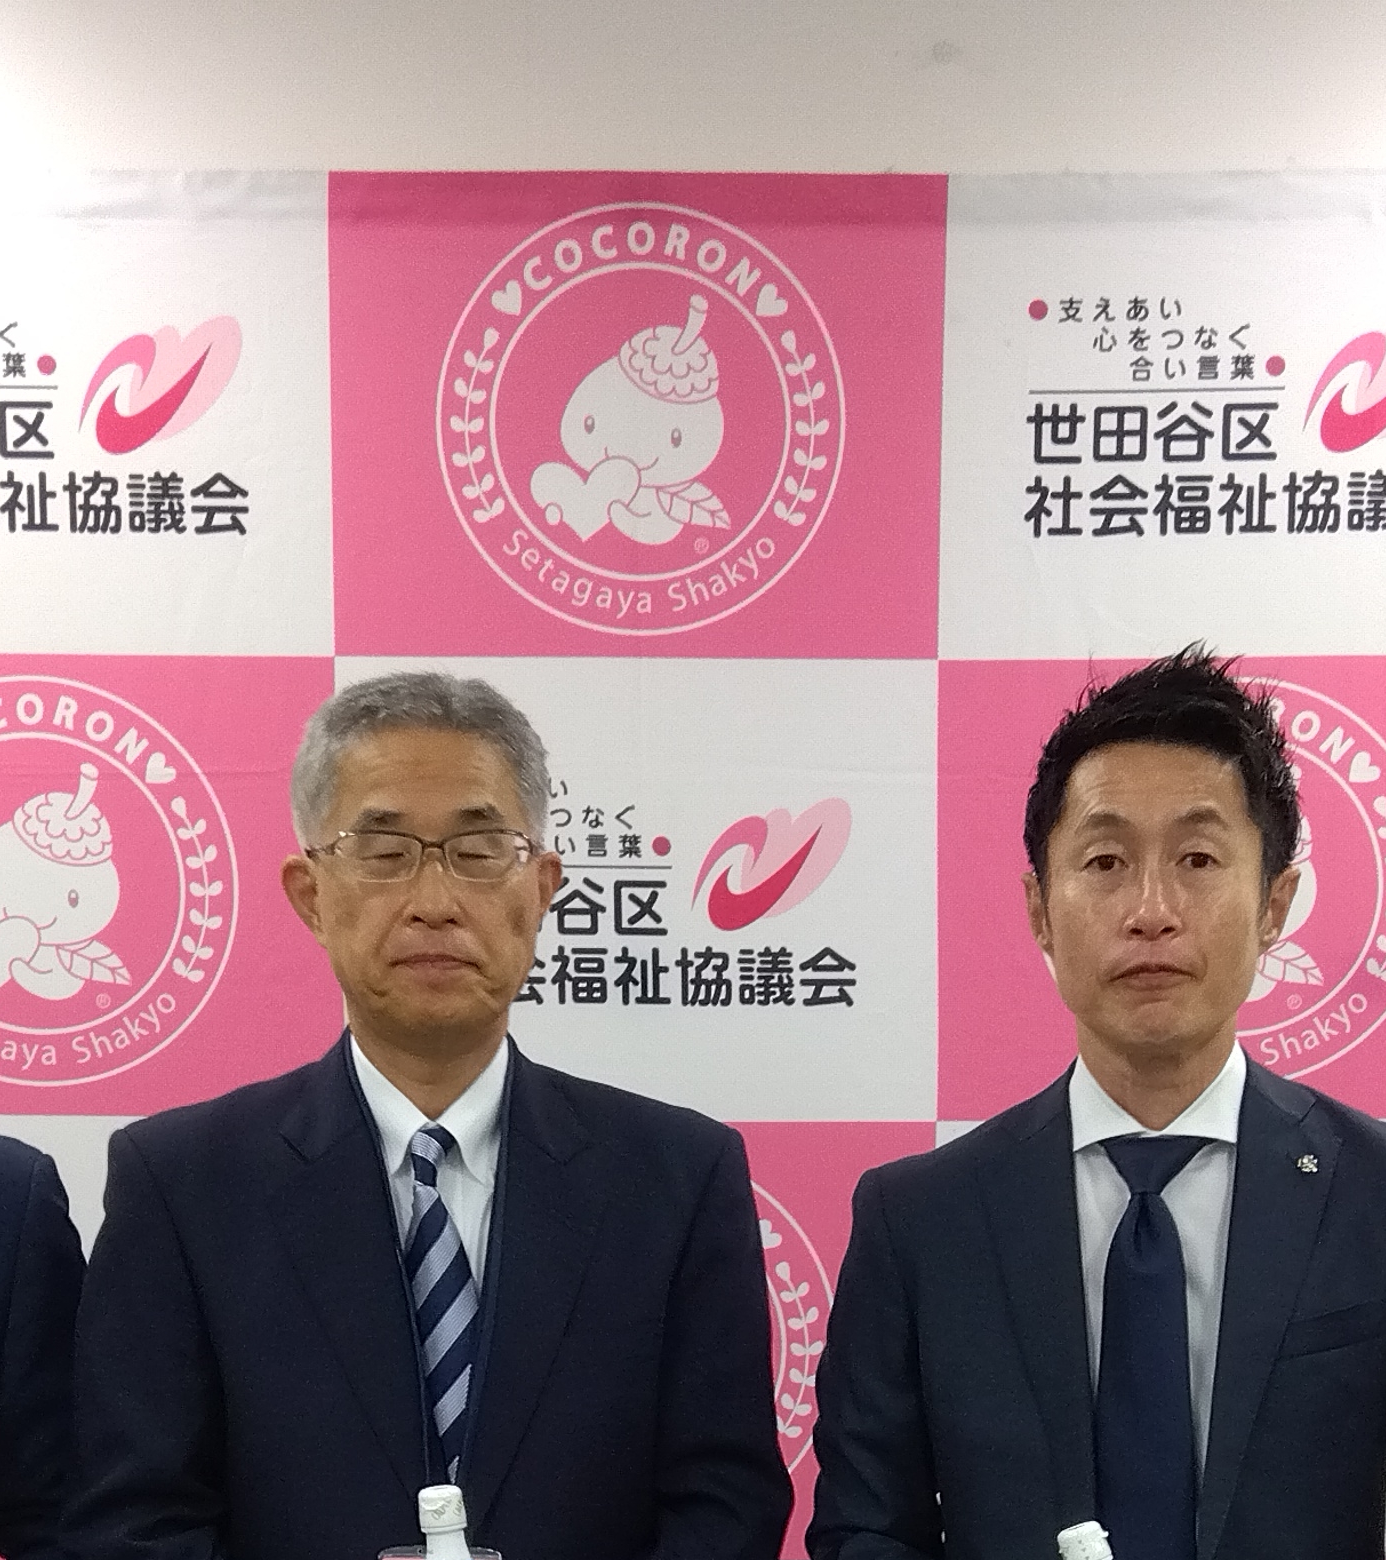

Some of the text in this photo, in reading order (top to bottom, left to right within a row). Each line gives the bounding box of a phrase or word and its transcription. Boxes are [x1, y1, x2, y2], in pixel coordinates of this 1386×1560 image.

[522, 222, 760, 296] COCORON
[1058, 296, 1182, 323] 支えあい
[1092, 324, 1248, 352] 心をつなく
[1129, 354, 1256, 382] 合い言葉
[1026, 400, 1279, 465] 世田谷区
[501, 528, 777, 618] Setagaya Shakyo
[553, 833, 643, 859] い言葉
[536, 876, 669, 936] 谷区
[71, 991, 178, 1065] Shakyo
[1259, 991, 1369, 1067] Shakyo
